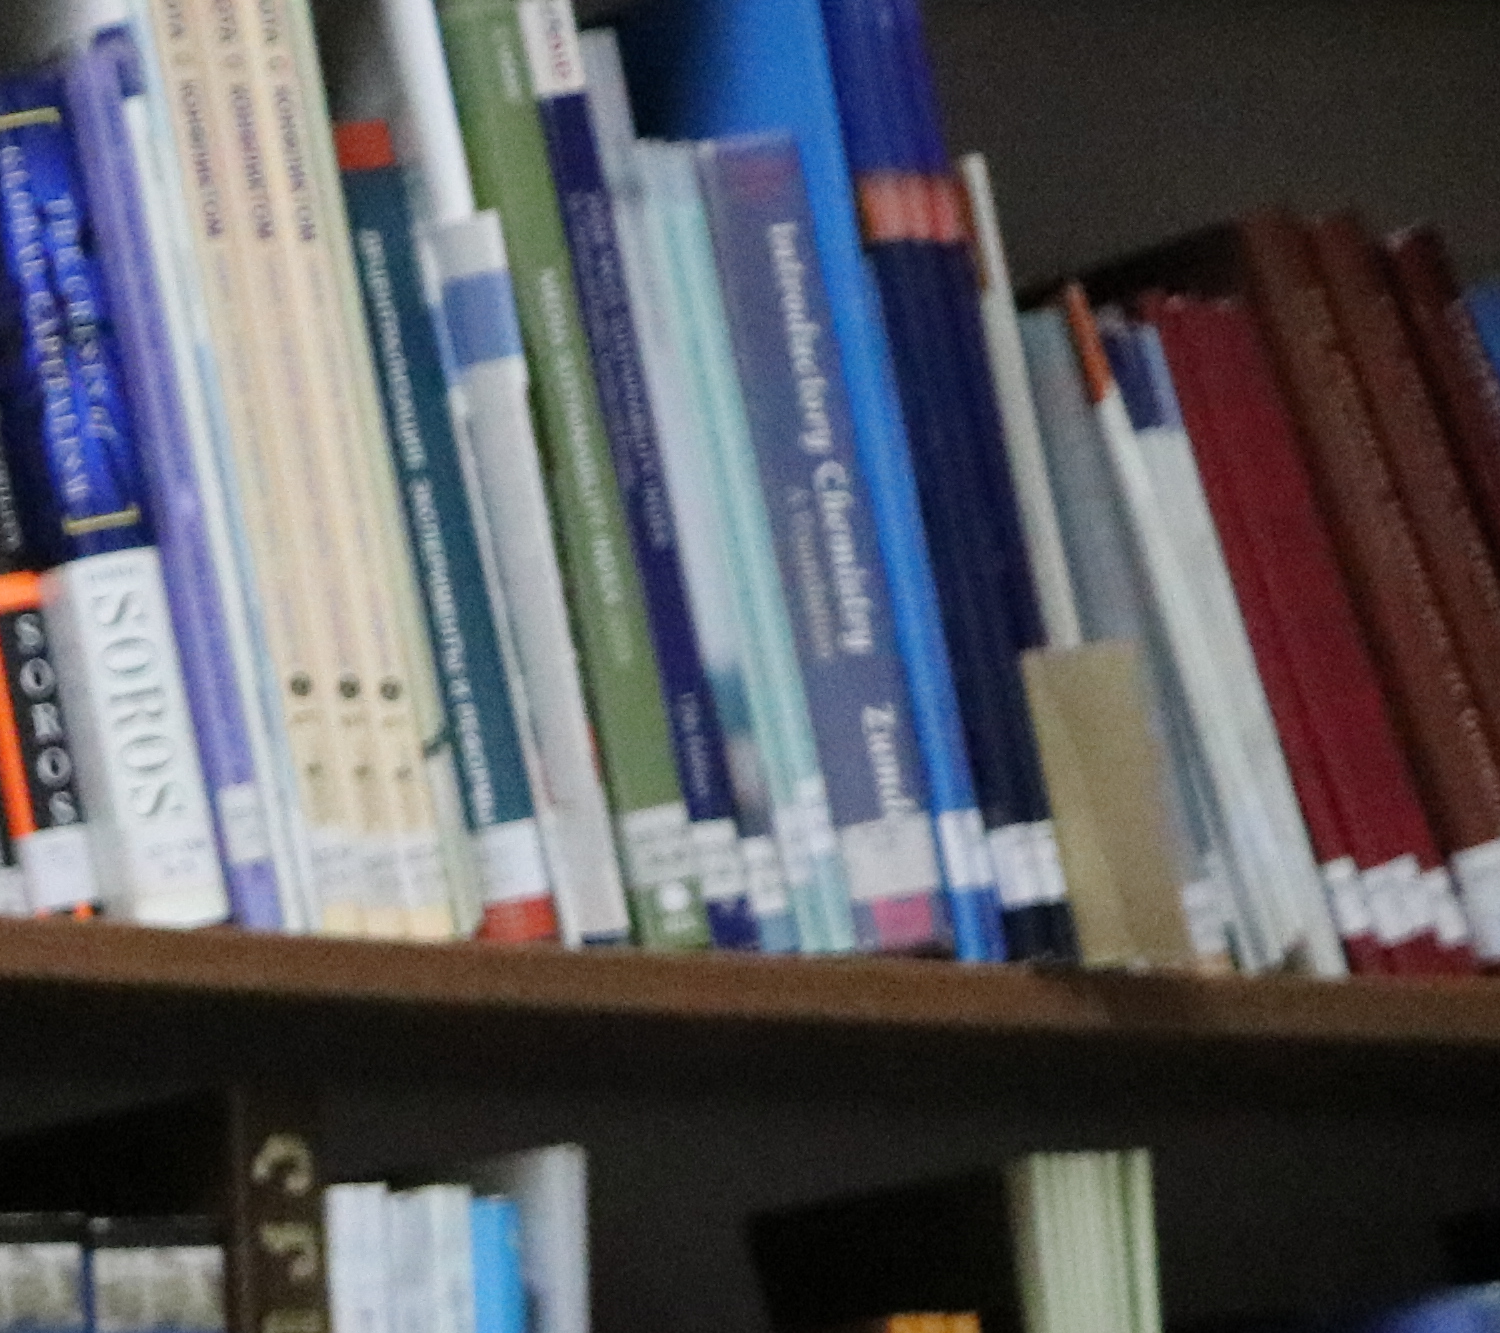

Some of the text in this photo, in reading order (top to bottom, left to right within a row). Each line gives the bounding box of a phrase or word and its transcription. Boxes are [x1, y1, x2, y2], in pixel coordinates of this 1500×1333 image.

[46, 195, 85, 264] THE
[61, 273, 109, 398] CRISIS
[25, 289, 90, 503] CAPITALISM
[758, 217, 917, 820] Introductory Chemistry Zumd
[10, 611, 78, 827] SOROS
[82, 585, 195, 824] SOROS
